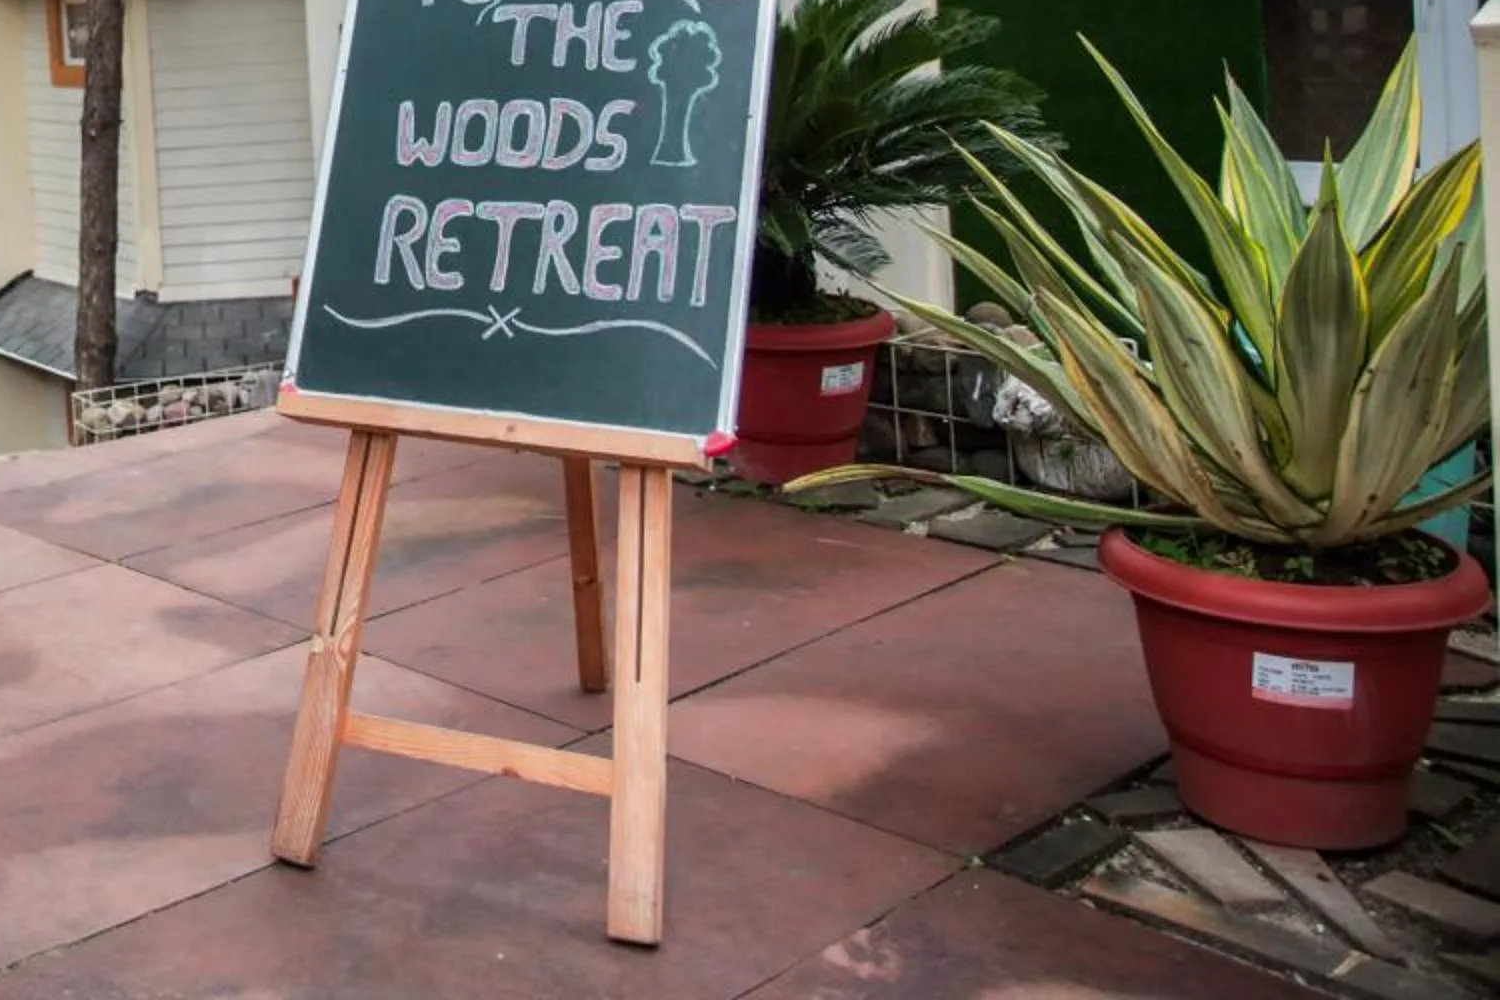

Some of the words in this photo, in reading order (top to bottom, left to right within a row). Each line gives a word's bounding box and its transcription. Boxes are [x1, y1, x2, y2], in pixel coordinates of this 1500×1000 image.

[492, 0, 645, 72] THE
[396, 97, 637, 171] WOODS
[374, 194, 736, 307] RETREAT
